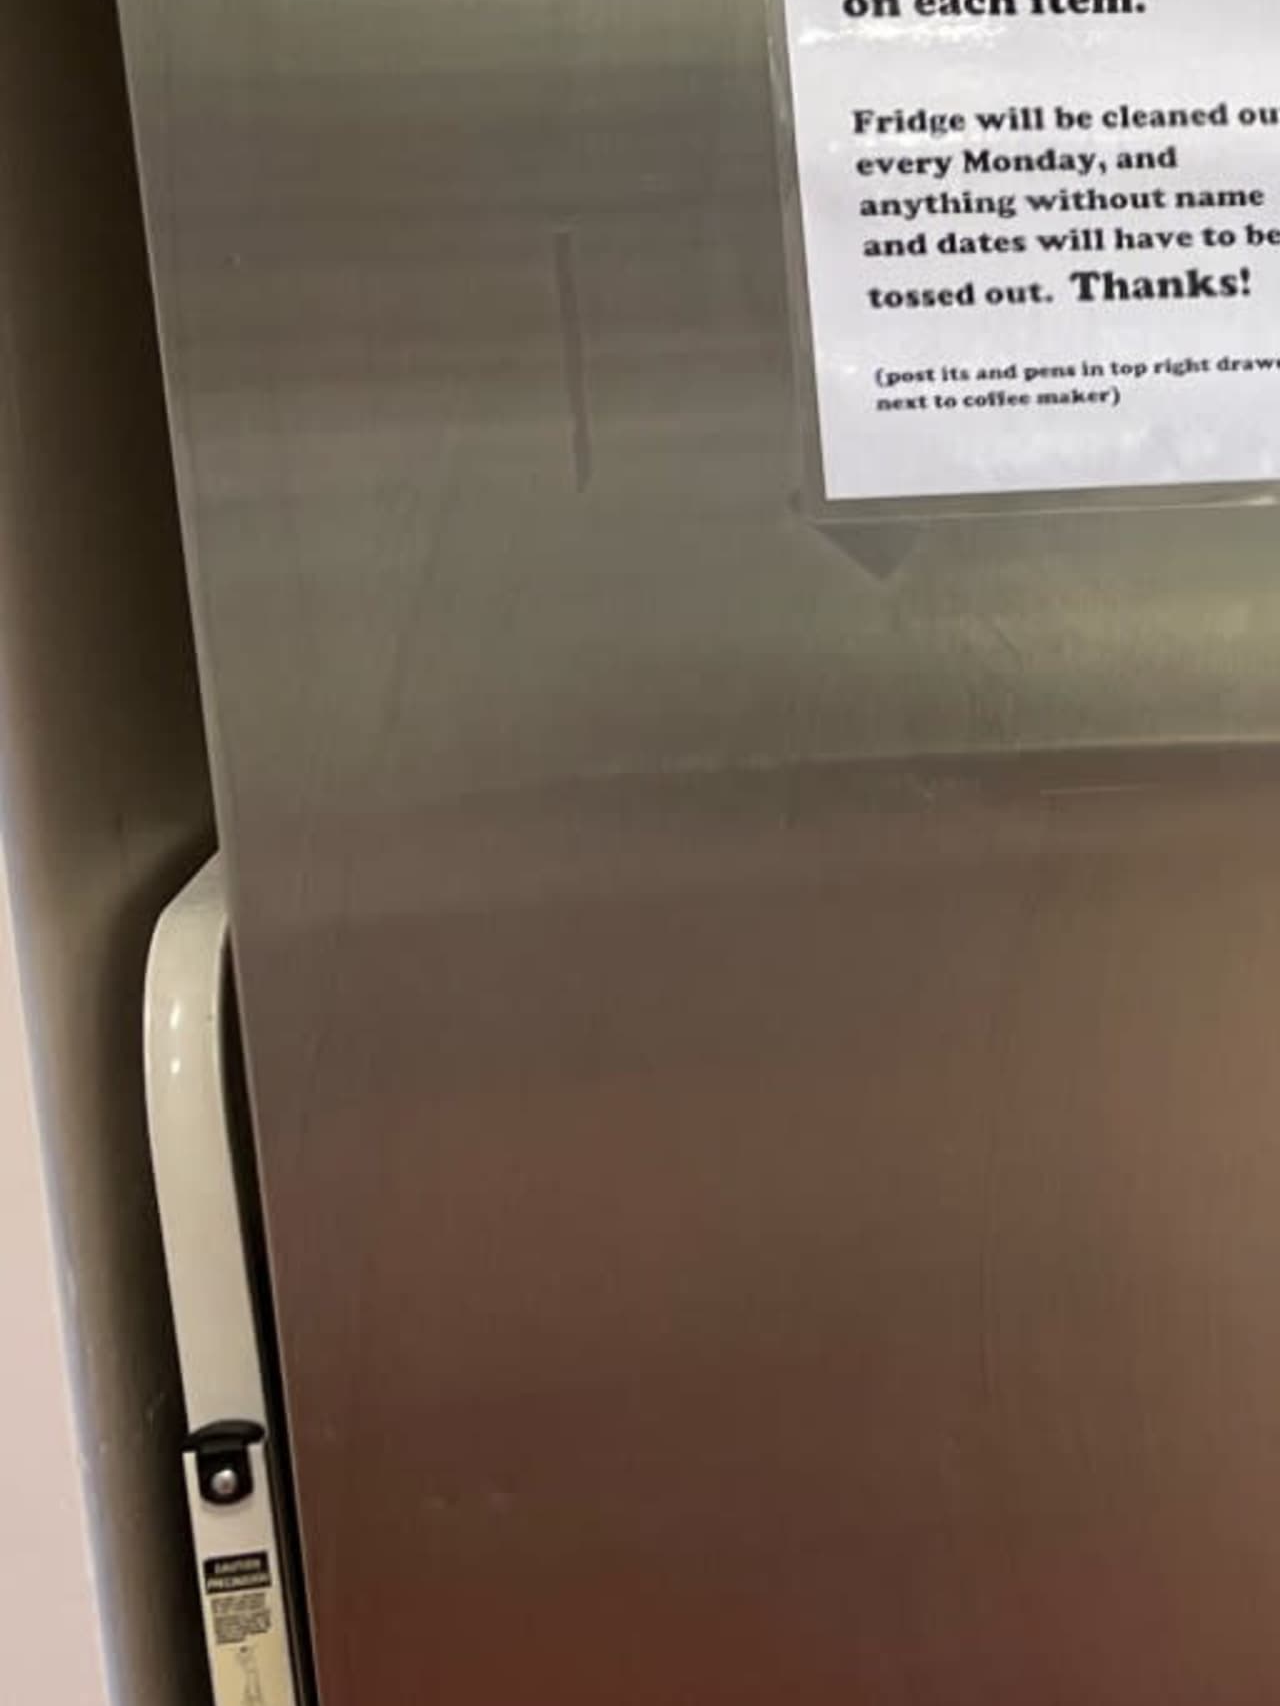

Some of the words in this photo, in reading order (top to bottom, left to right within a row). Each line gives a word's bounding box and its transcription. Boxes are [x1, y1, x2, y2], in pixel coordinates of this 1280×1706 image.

[853, 108, 966, 136] Fridge
[975, 106, 1045, 131] will
[1054, 106, 1093, 130] be
[1101, 102, 1229, 129] cleaned
[855, 155, 953, 180] every
[962, 148, 1107, 177] Monday,
[1116, 145, 1178, 170] and
[859, 190, 1017, 221] anything
[1025, 188, 1166, 212] without
[1175, 189, 1265, 209] name
[863, 232, 928, 257] and
[936, 232, 1027, 255] dates
[1036, 227, 1105, 252] will
[1113, 226, 1193, 251] have
[1201, 227, 1237, 248] to
[867, 281, 976, 309] tossed
[984, 282, 1054, 305] out.
[1068, 266, 1251, 302] Thanks!
[874, 367, 936, 388] (post
[941, 366, 971, 383] its
[975, 363, 1018, 382] and
[1023, 365, 1077, 383] pens
[1081, 360, 1105, 378] in
[1109, 361, 1149, 379] top
[1153, 357, 1211, 378] right
[876, 395, 928, 411] next
[933, 394, 958, 409] to
[962, 390, 1031, 408] coffee
[1036, 385, 1121, 407] maker)
